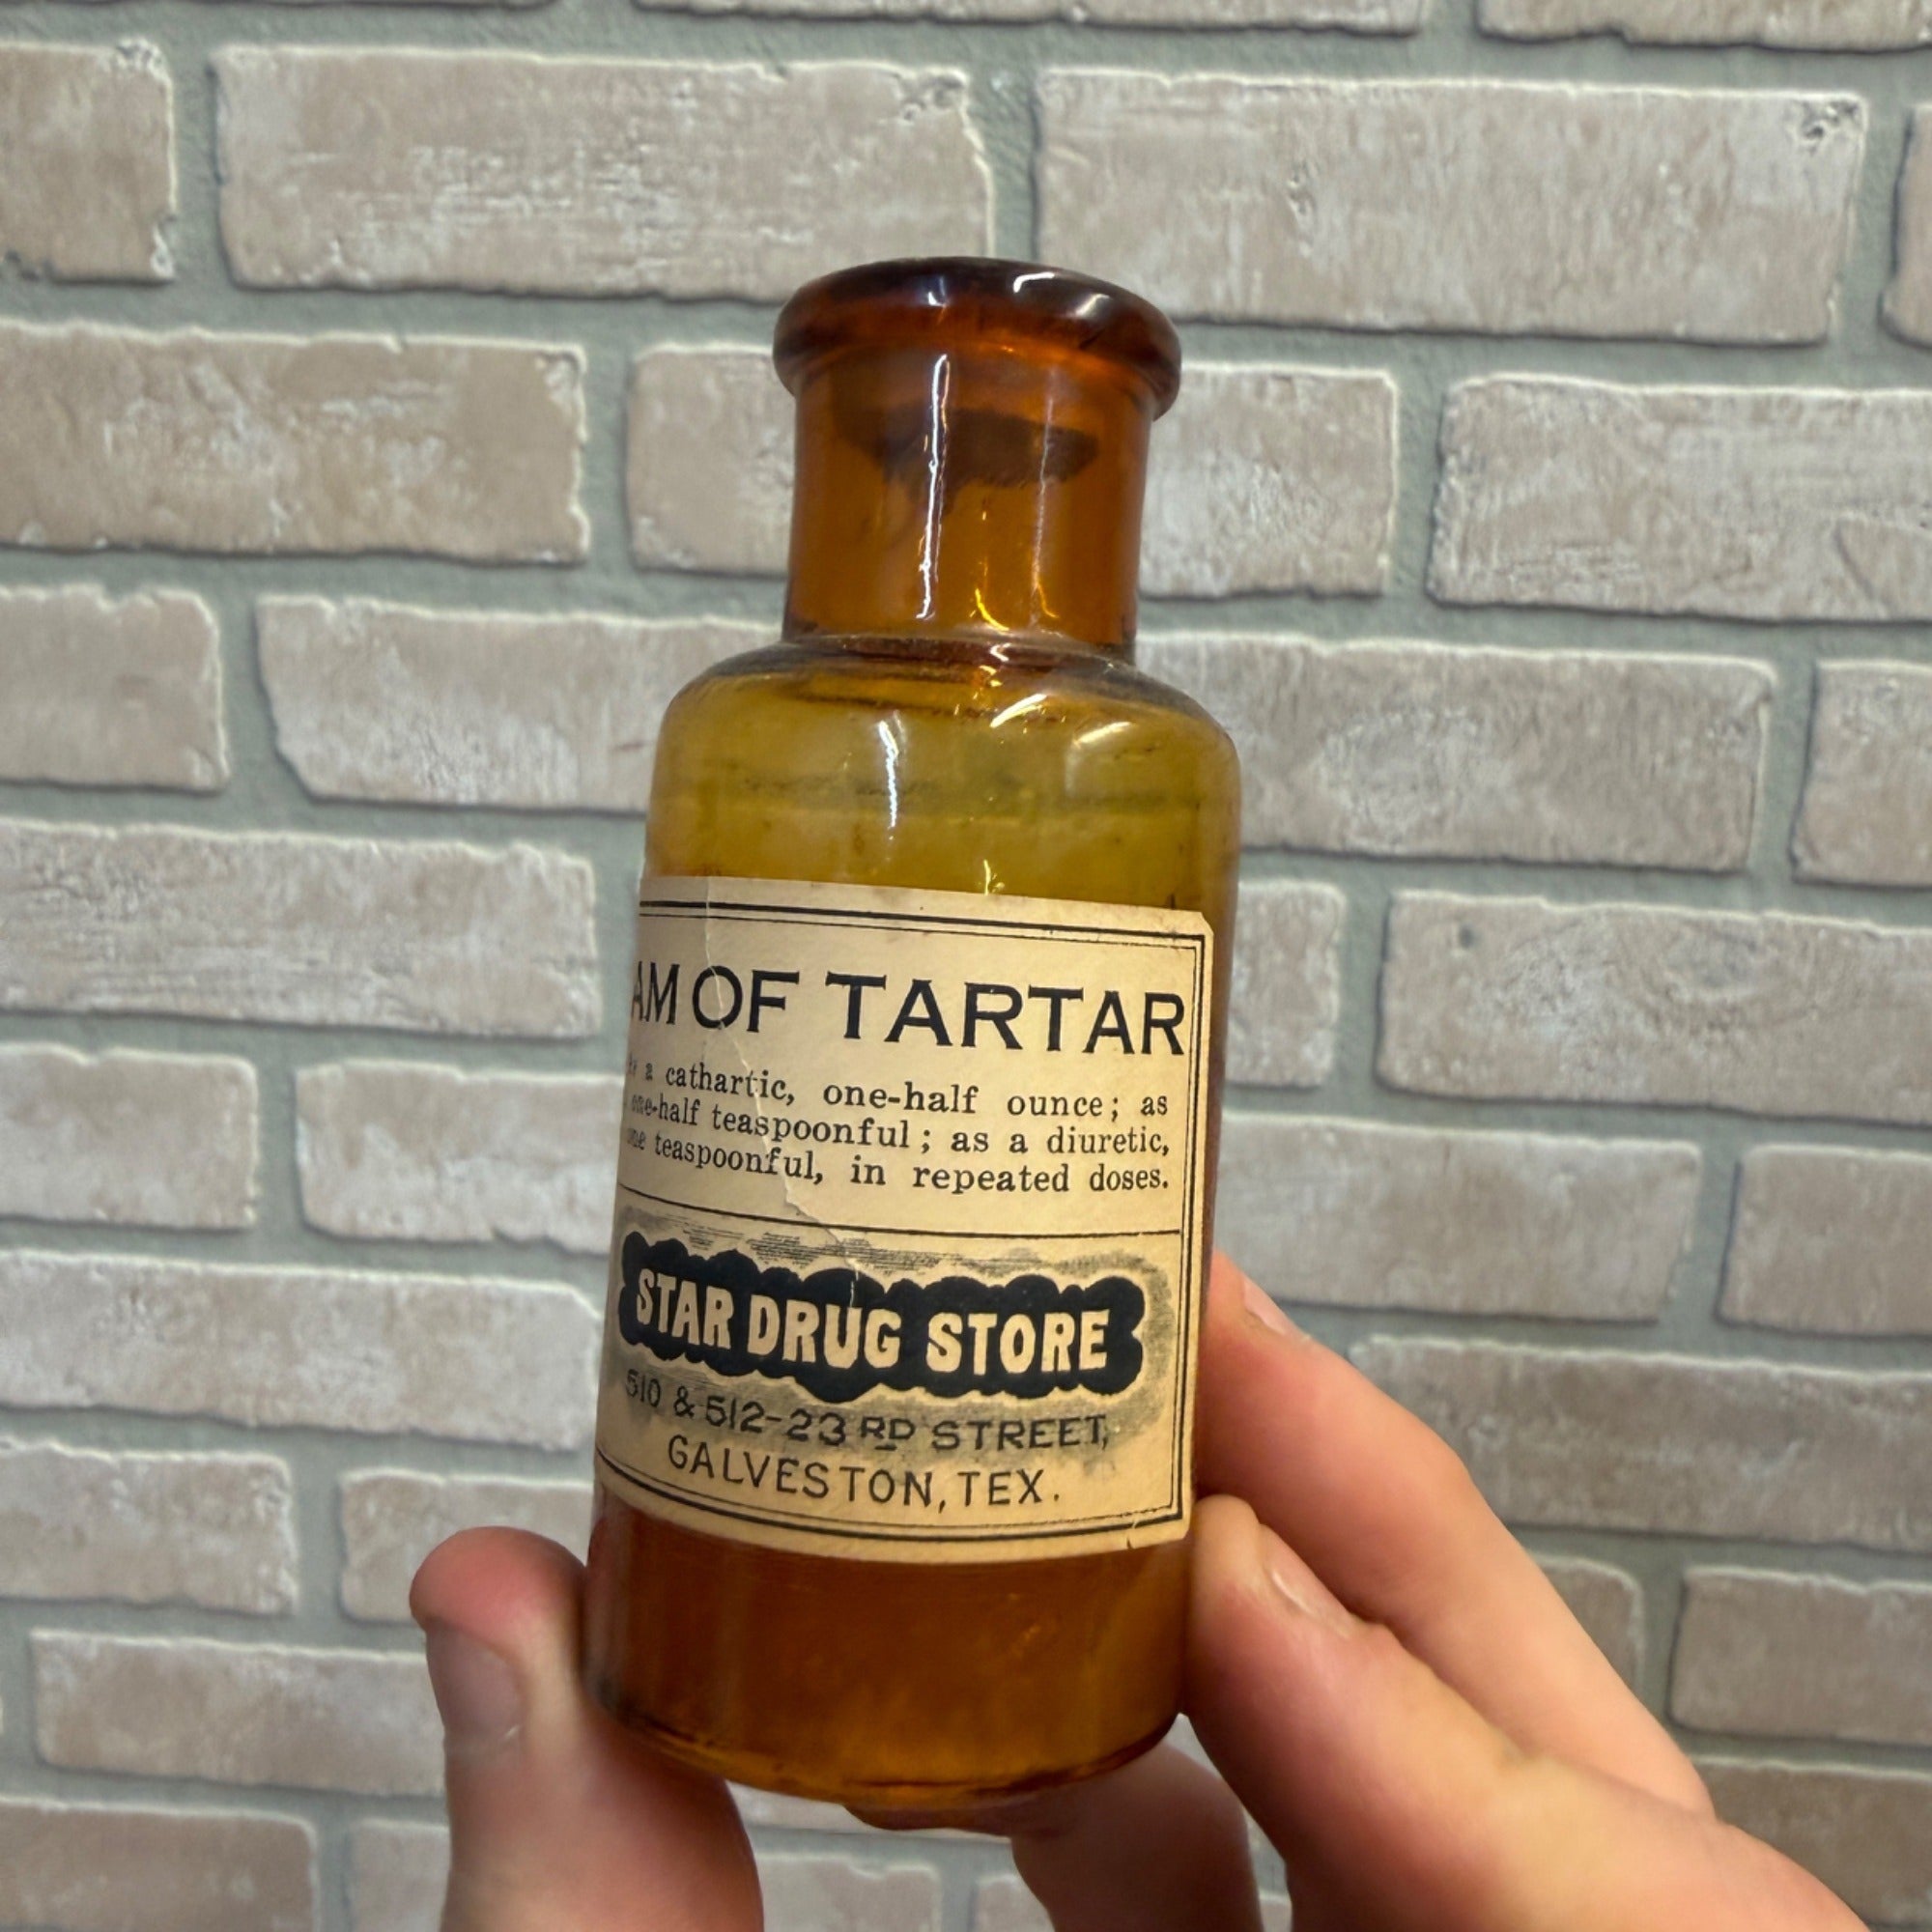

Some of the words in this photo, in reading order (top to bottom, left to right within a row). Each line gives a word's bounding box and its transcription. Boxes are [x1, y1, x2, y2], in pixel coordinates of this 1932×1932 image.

[693, 965, 800, 1033] OF
[825, 971, 1185, 1056] TARTAR
[666, 1062, 796, 1106] cathartic,
[823, 1081, 979, 1115] one-half
[1140, 1095, 1169, 1117] as
[654, 1132, 823, 1186] teaspoonful,
[850, 1154, 886, 1185] in
[913, 1164, 1069, 1195] repeated
[1089, 1163, 1169, 1193] doses.
[951, 1131, 989, 1153] as
[1009, 1132, 1029, 1154] a
[1047, 1125, 1170, 1156] diuretic,
[636, 1268, 734, 1350] STAR
[747, 1294, 902, 1370] DRUG
[926, 1309, 1110, 1376] STORE
[626, 1369, 662, 1408] 510
[673, 1384, 696, 1419] &
[931, 1414, 1110, 1451] STREET,
[668, 1435, 947, 1514] GALVESTON,
[957, 1468, 1061, 1507] TEX.
